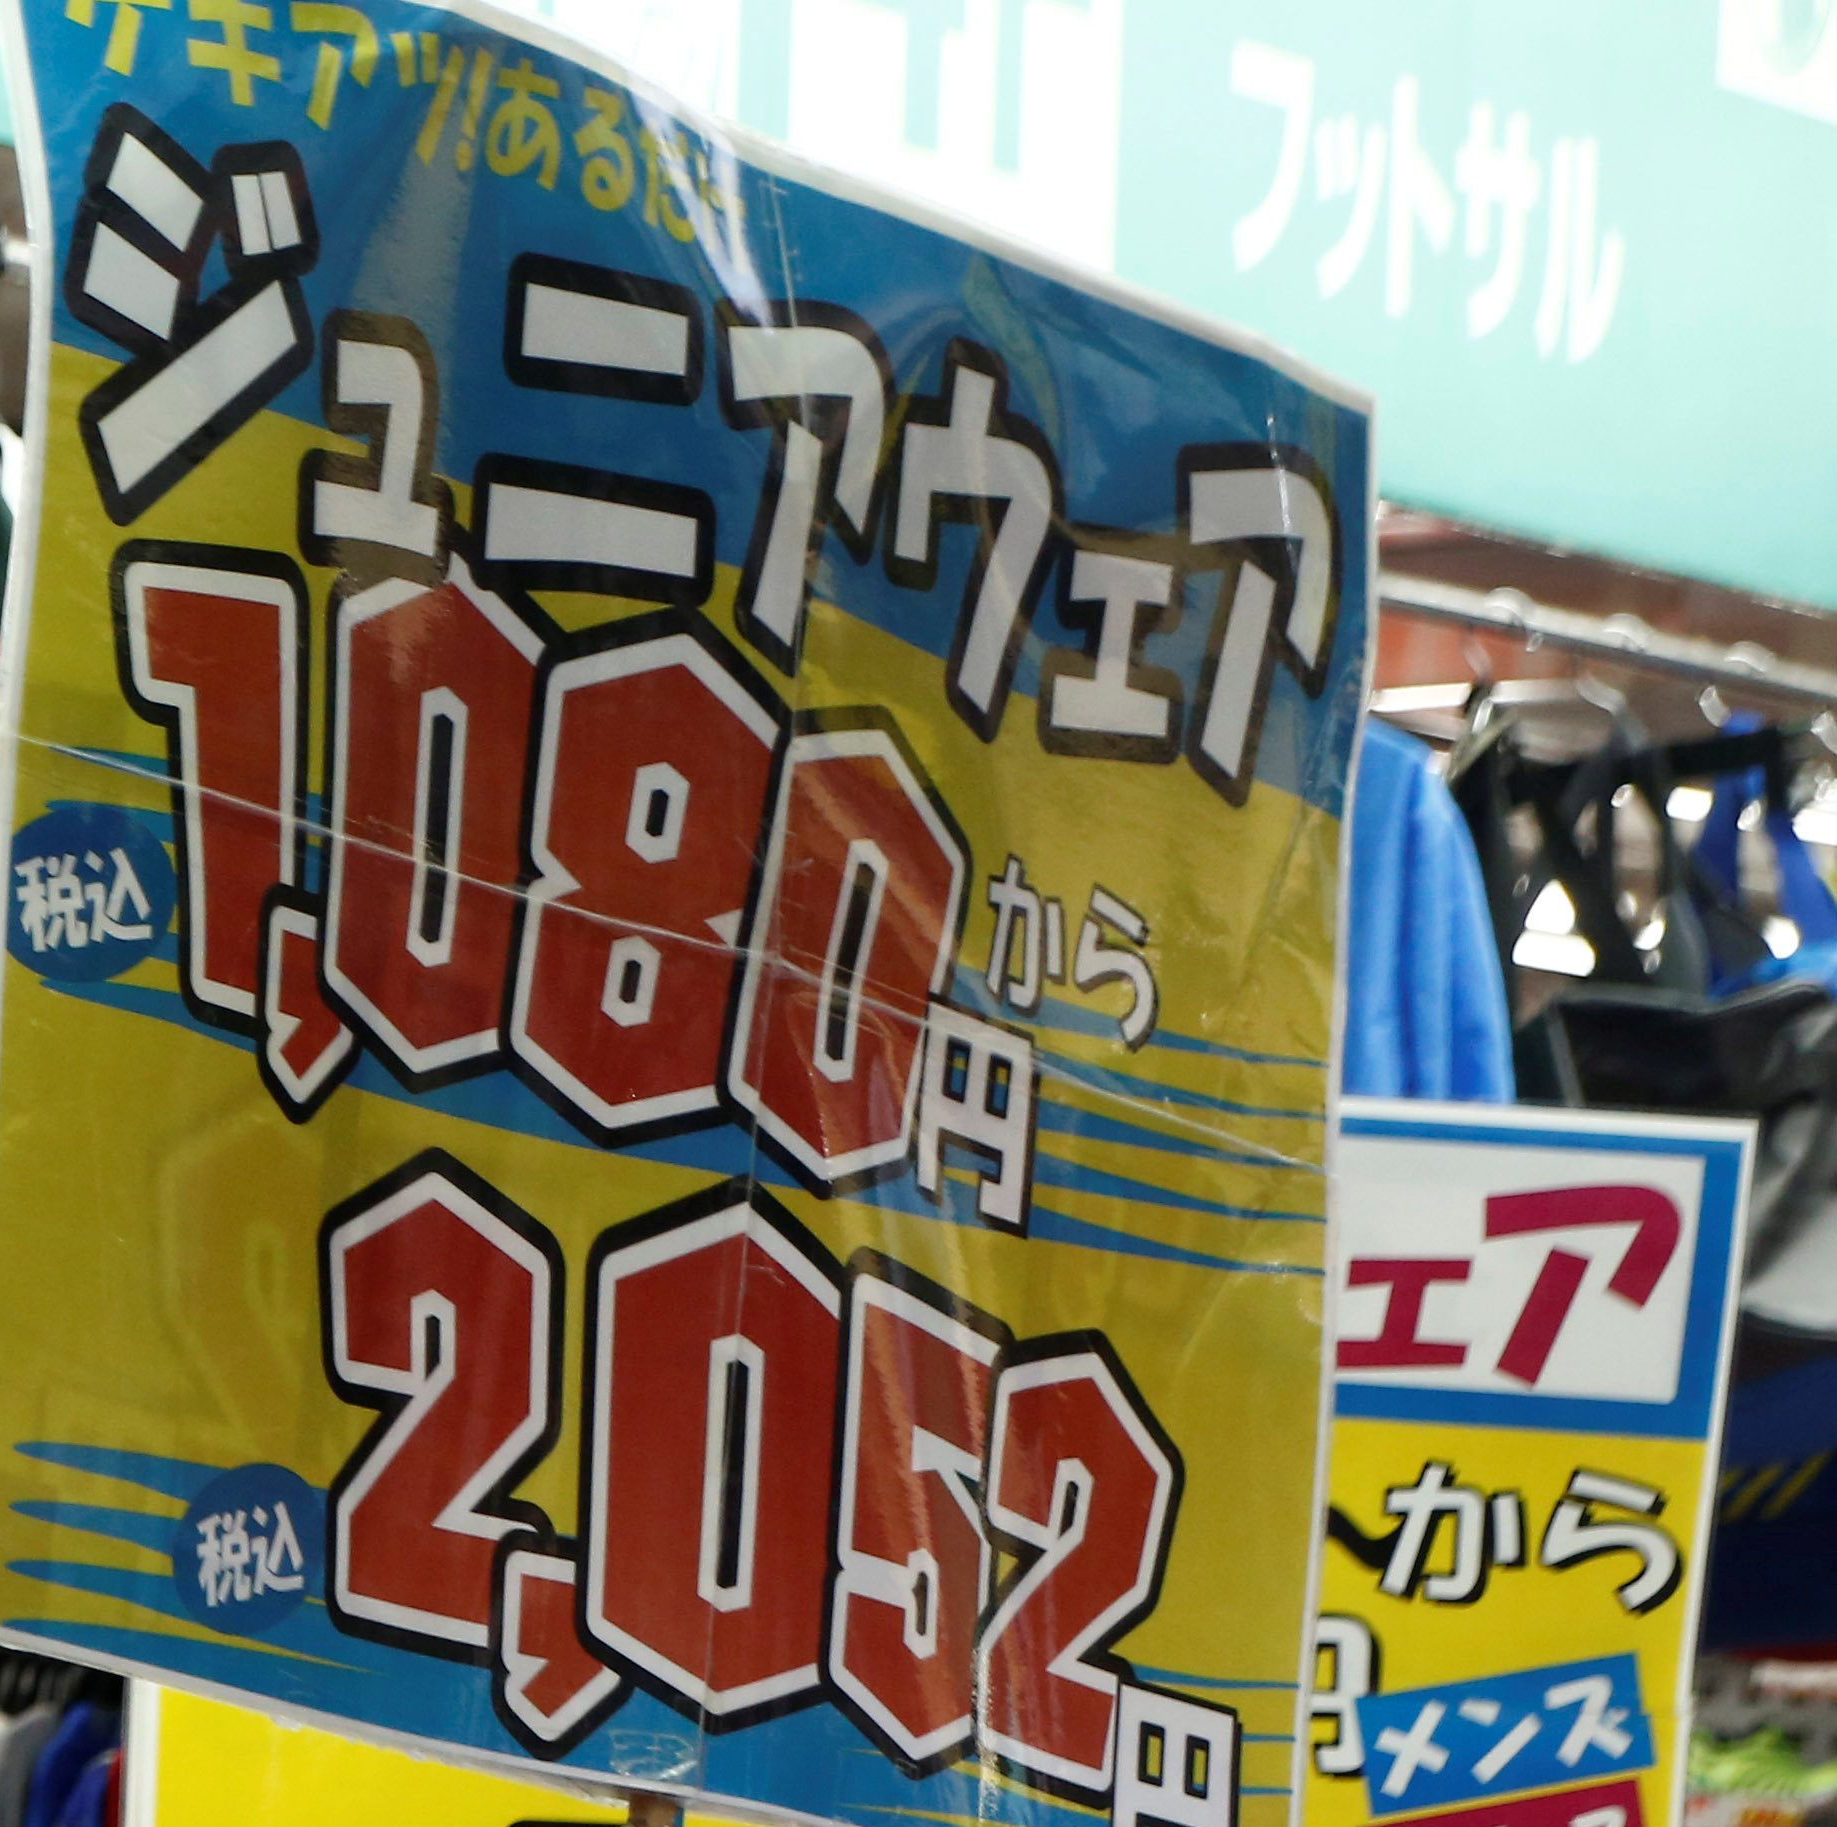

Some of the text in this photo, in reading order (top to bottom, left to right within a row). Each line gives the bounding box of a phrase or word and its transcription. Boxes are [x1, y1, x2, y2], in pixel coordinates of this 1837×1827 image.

[1229, 38, 1626, 366] フットサル
[64, 100, 1338, 806] ジュニアウェア
[14, 846, 154, 956] 税込
[194, 1500, 308, 1608] 税込
[1374, 1674, 1634, 1800] メンズ
